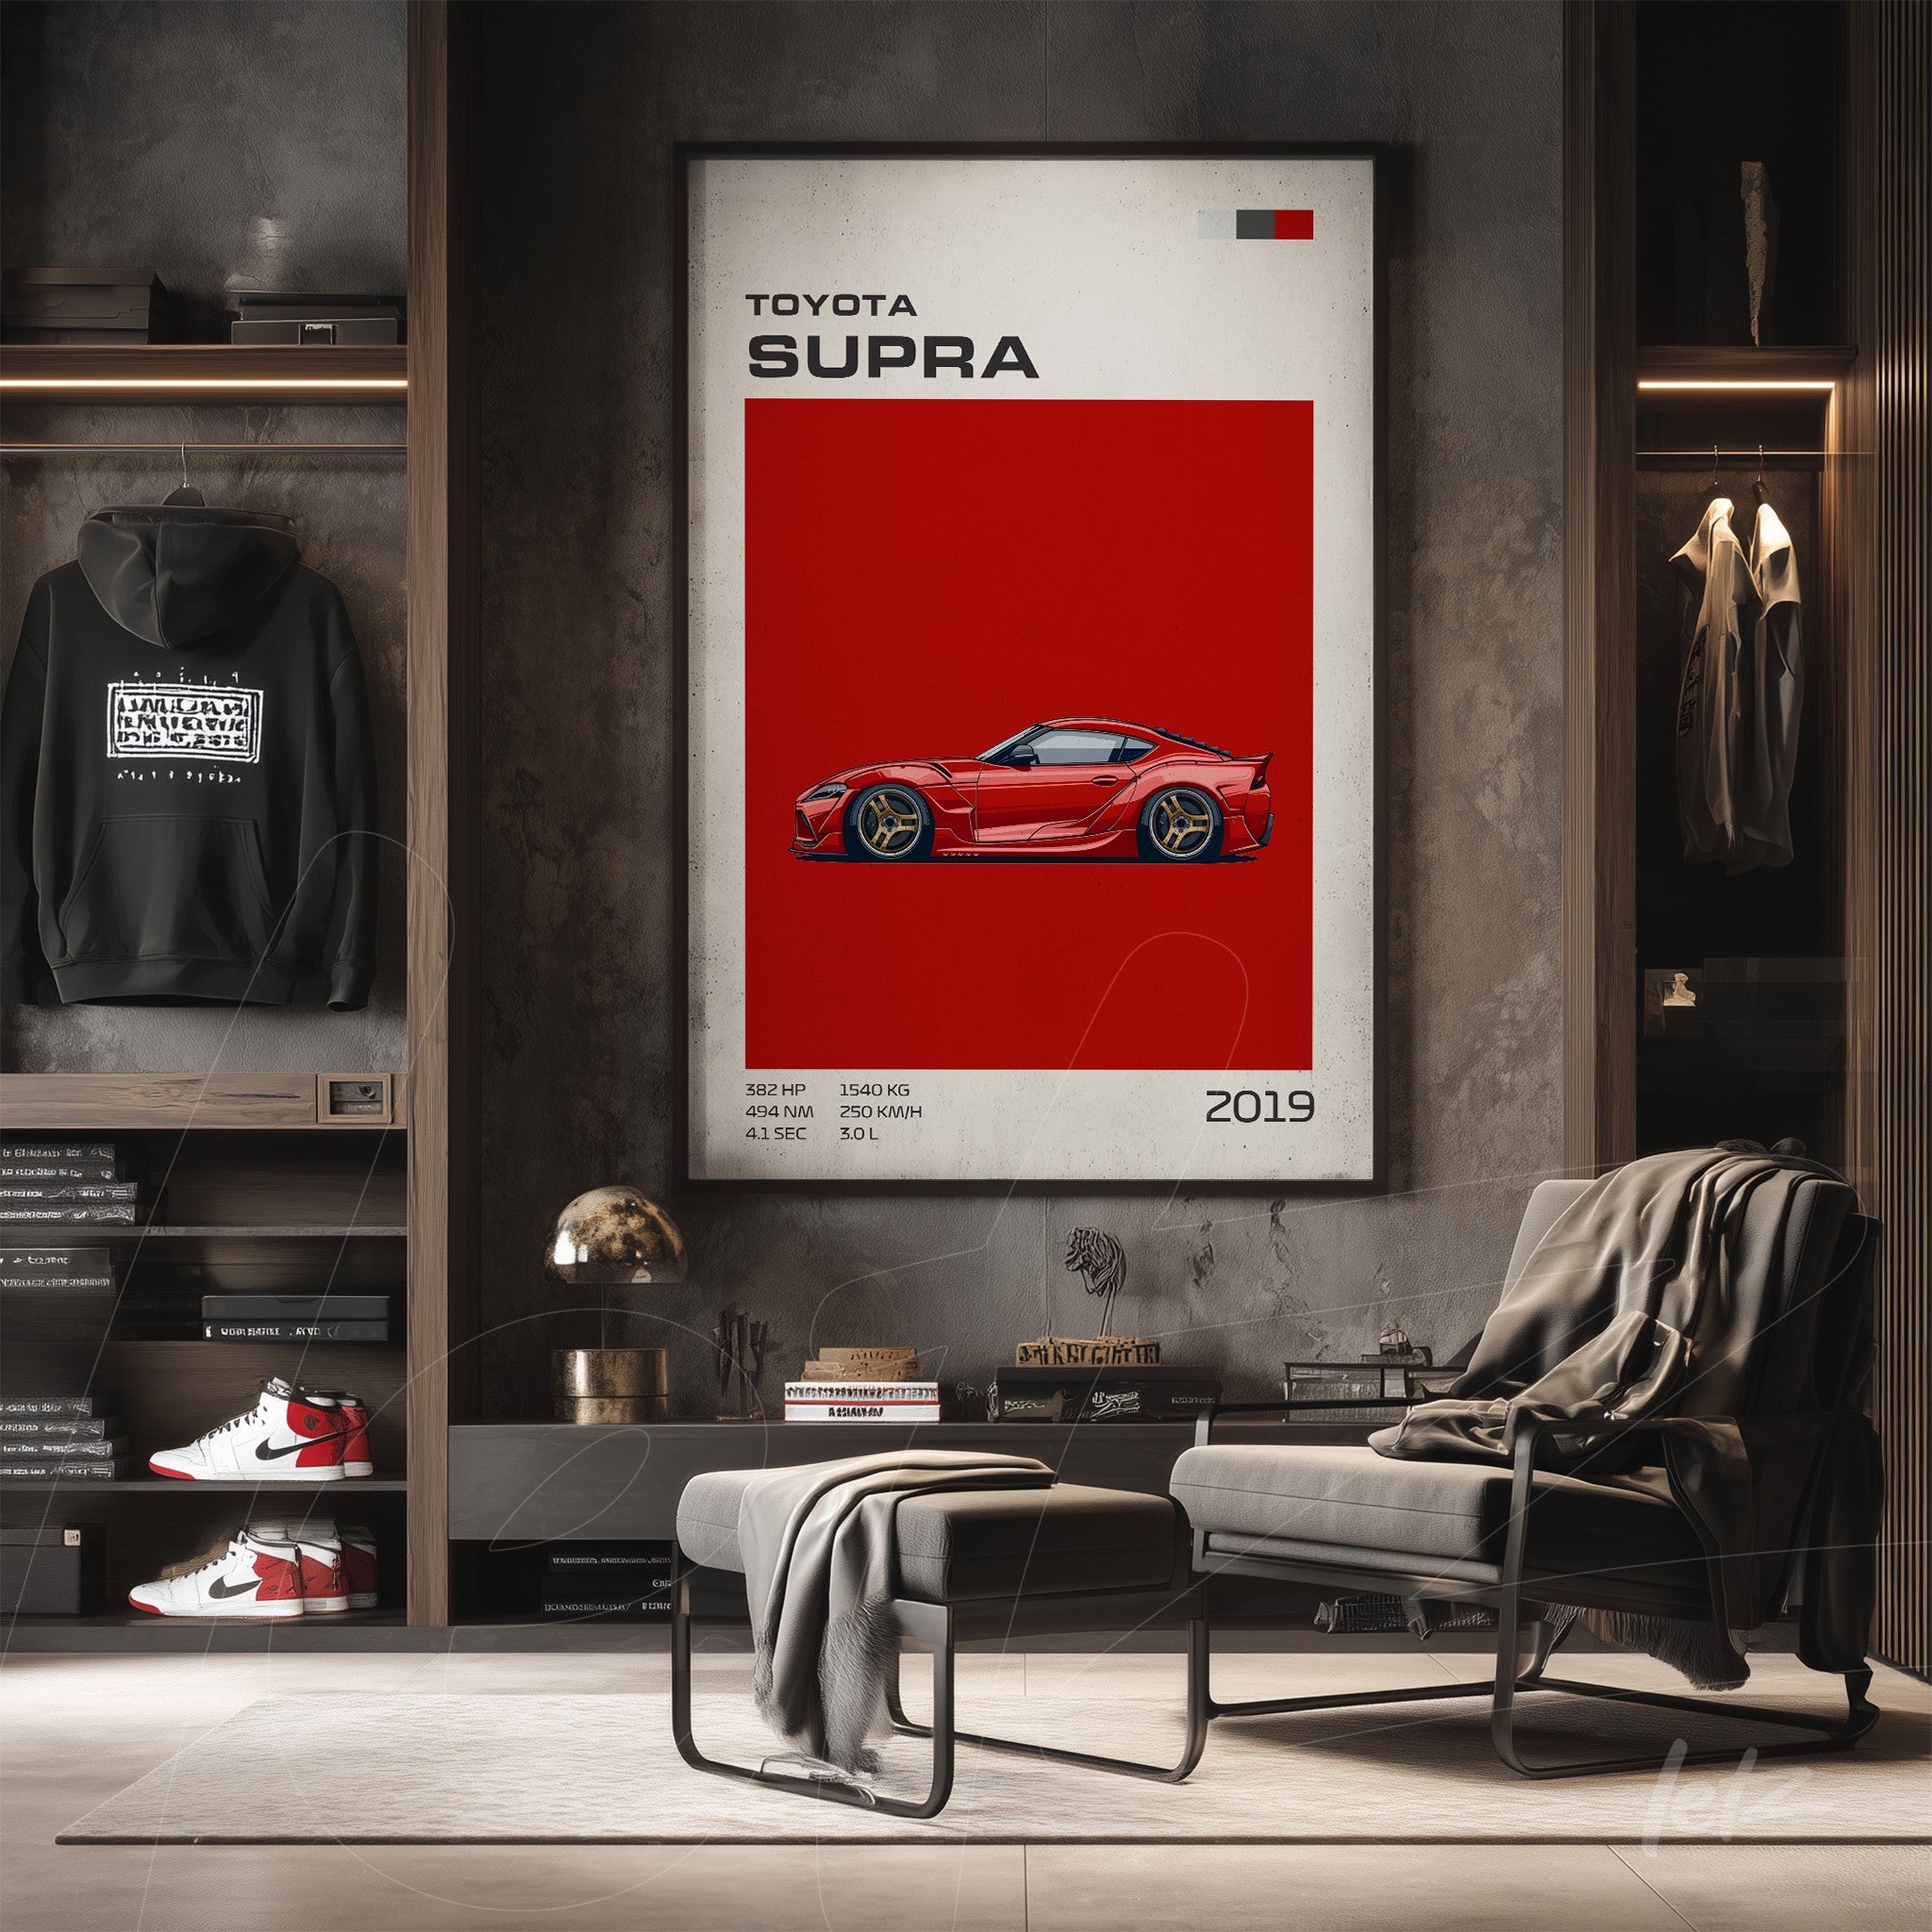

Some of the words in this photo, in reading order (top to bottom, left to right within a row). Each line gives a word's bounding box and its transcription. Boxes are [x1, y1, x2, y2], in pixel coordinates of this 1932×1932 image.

[745, 293, 918, 317] TOYOTA
[748, 334, 1040, 379] SUPRA
[744, 1083, 777, 1096] 382
[782, 1083, 806, 1096] HP
[840, 1083, 883, 1097] 1540
[887, 1083, 910, 1097] KG
[744, 1105, 779, 1118] 494
[783, 1105, 814, 1119] NM
[839, 1105, 873, 1119] 250
[876, 1105, 923, 1120] KM/H
[1206, 1090, 1315, 1124] 2019
[744, 1126, 771, 1141] 4.1
[774, 1126, 808, 1141] SEC
[840, 1126, 865, 1141] 3.0
[868, 1126, 879, 1141] L
